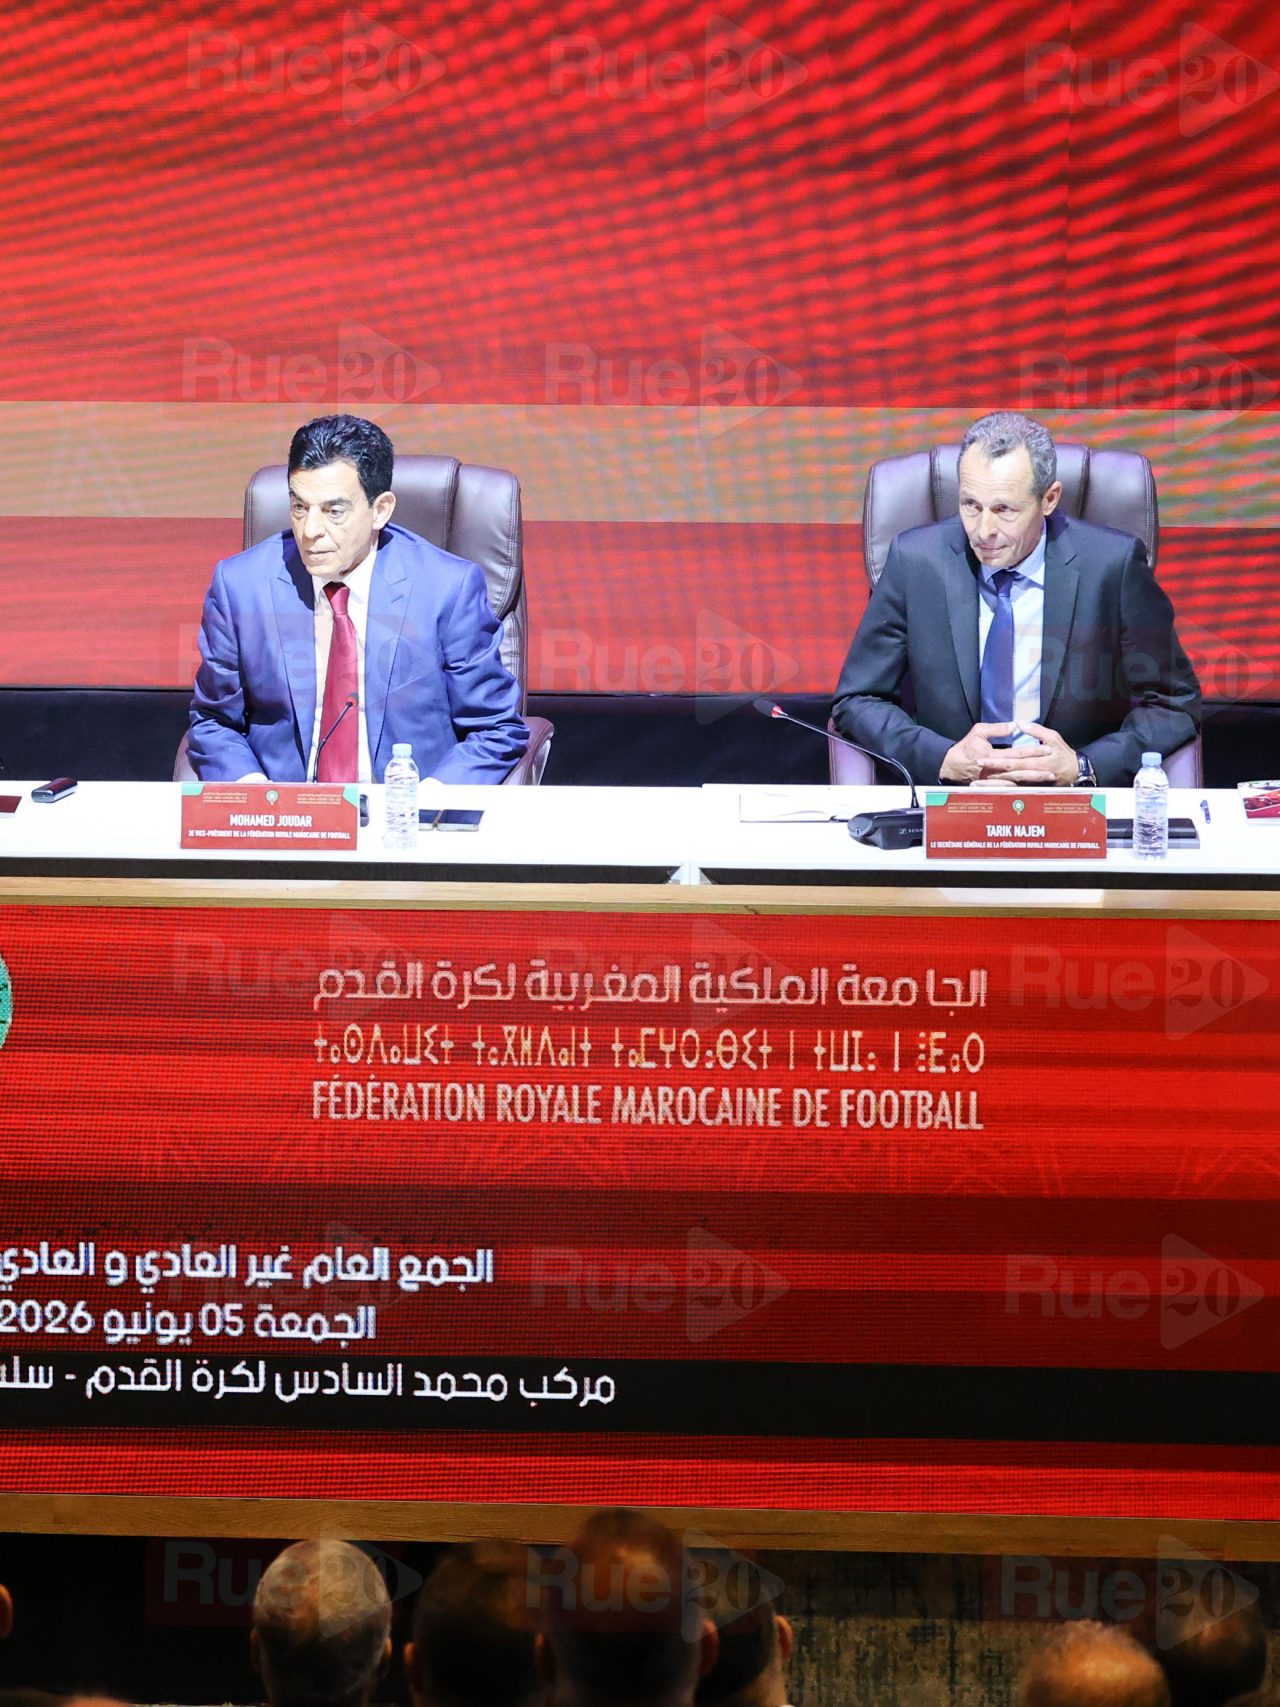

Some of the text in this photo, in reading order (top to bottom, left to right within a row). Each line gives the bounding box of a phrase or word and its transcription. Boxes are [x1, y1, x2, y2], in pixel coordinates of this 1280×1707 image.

[230, 814, 312, 827] MOHAMED JOUDAR
[986, 825, 1045, 837] TARIK NAJEM
[313, 960, 423, 1011] القدم
[431, 960, 516, 1009] لكرة
[525, 959, 681, 1011] المغربية
[689, 961, 830, 1013] الملكية
[312, 1073, 984, 1130] FÉDÉRATION ROYALE MAROCAINE DE FOOTBALL
[104, 1250, 128, 1286] و
[135, 1243, 236, 1293] العادي
[244, 1245, 293, 1288] غير
[302, 1246, 389, 1288] العام
[397, 1248, 493, 1292] الجمع
[103, 1301, 193, 1345] يونيو
[198, 1303, 244, 1337] 05
[253, 1305, 376, 1349] الجمعة
[85, 1358, 182, 1399] القدم
[192, 1359, 266, 1399] لكرة
[275, 1362, 402, 1403] السادس
[413, 1371, 507, 1401] محمد
[519, 1366, 615, 1407] مركب
